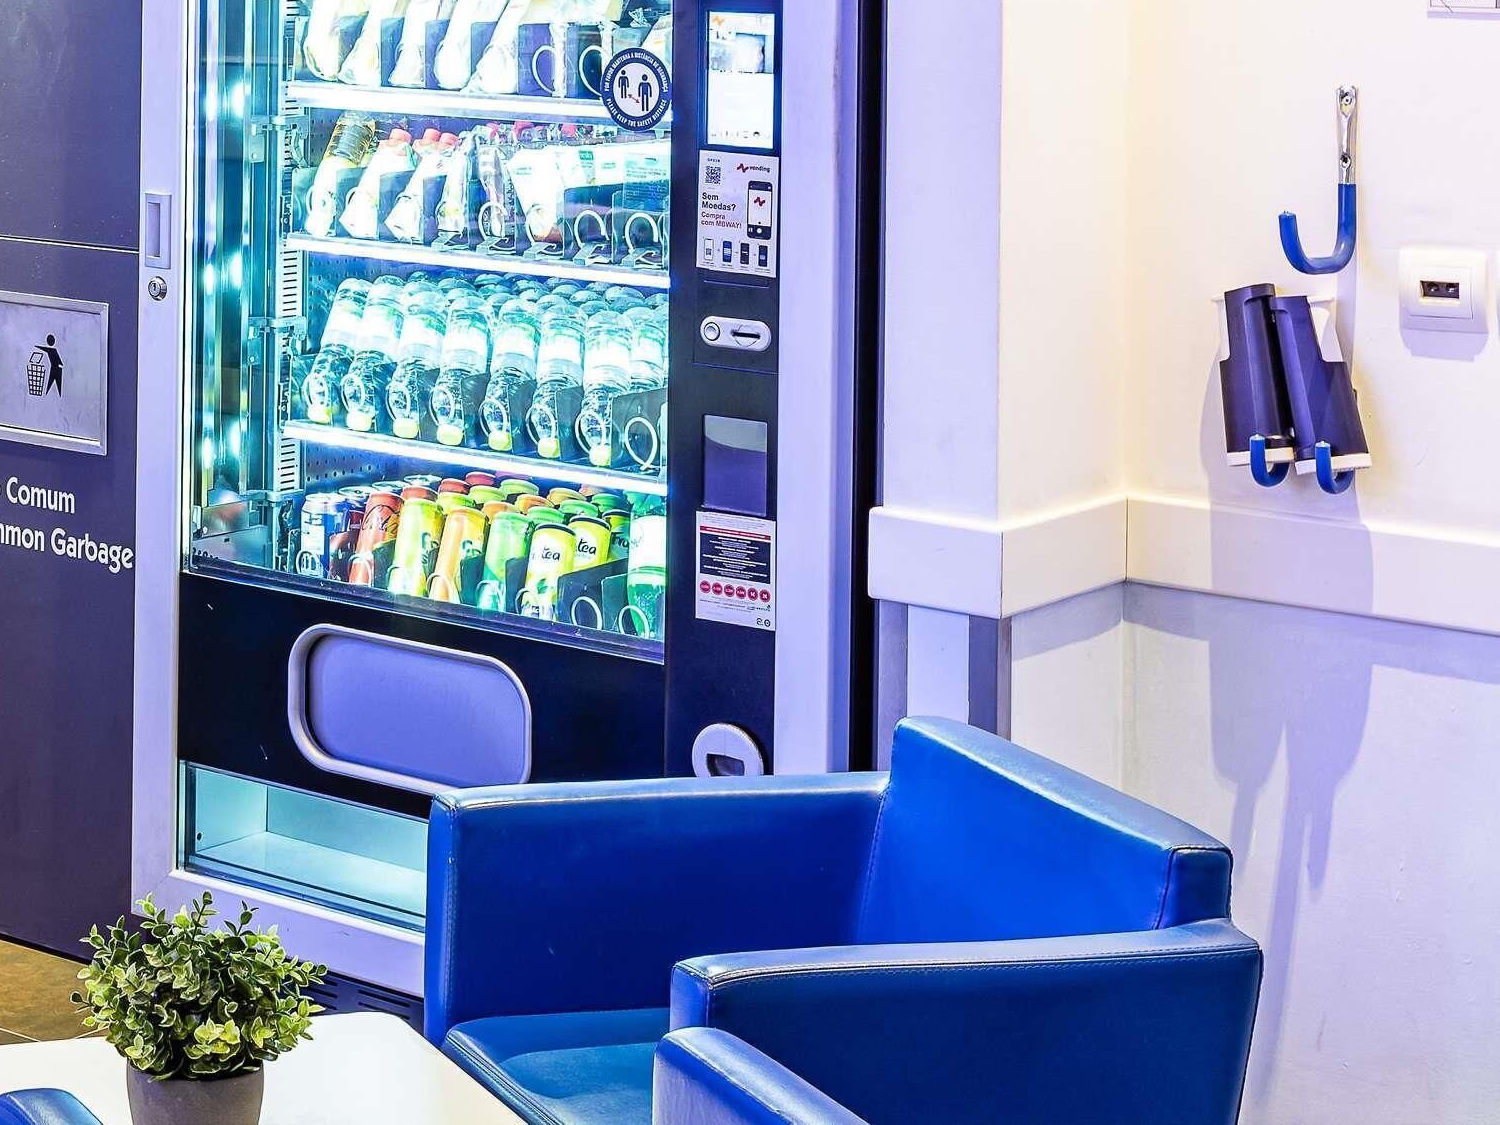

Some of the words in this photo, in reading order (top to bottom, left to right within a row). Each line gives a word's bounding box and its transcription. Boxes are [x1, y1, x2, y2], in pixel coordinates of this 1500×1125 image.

[701, 192, 719, 201] Sem
[701, 201, 737, 212] Moedas?
[701, 211, 726, 220] Compra
[5, 476, 76, 514] Comum
[50, 527, 135, 574] Garbage
[541, 546, 561, 561] tea
[578, 537, 597, 556] tea
